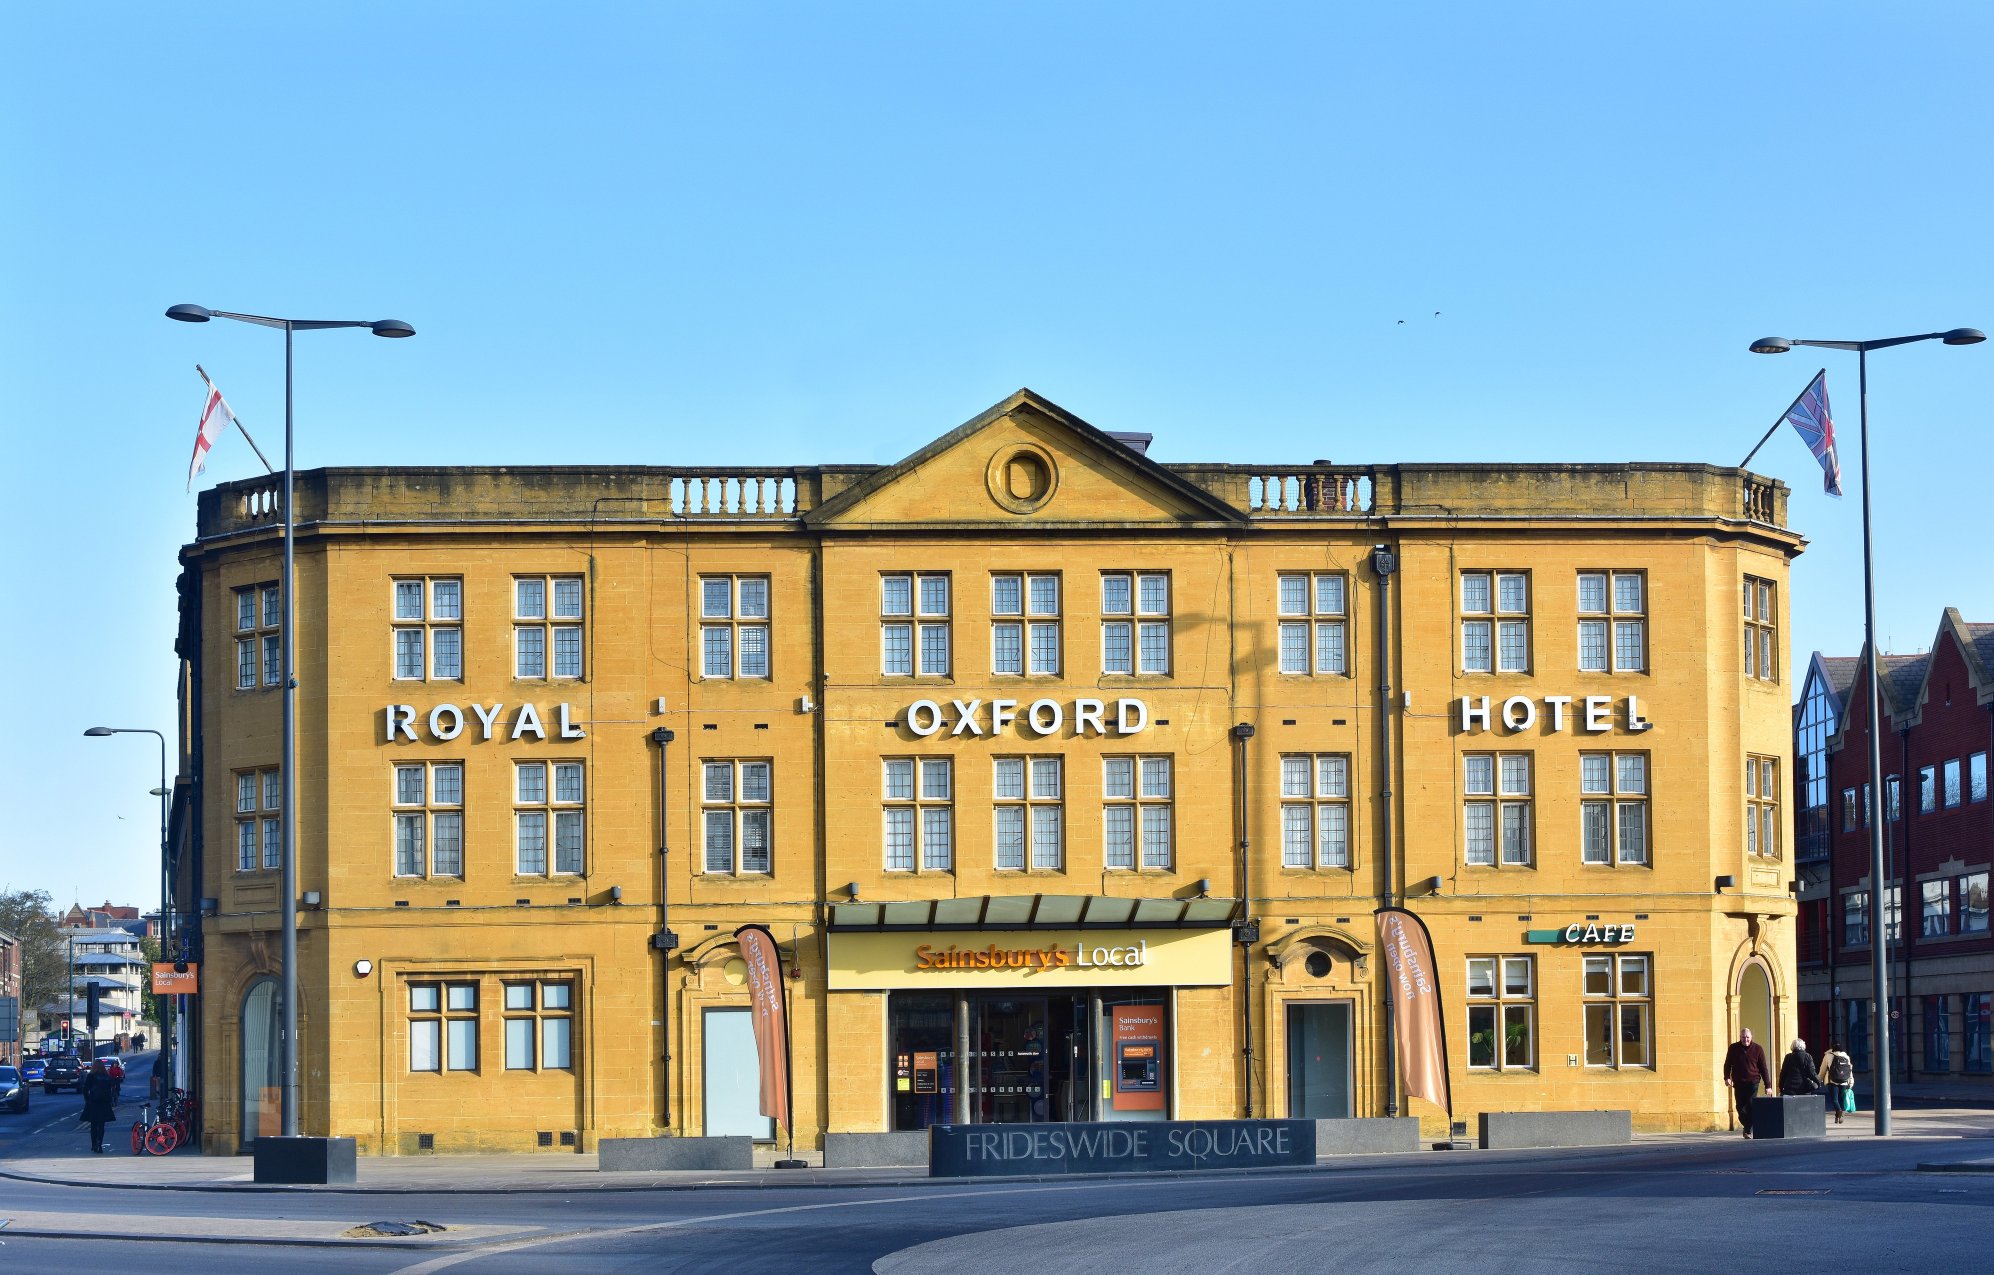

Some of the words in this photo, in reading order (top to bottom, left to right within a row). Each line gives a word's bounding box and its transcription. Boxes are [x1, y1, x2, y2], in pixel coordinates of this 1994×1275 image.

[386, 703, 587, 741] ROYAL
[907, 698, 1148, 736] OXFORD
[1462, 695, 1653, 731] HOTEL
[1565, 922, 1635, 943] CAFE
[915, 943, 1070, 974] Sainsbury's
[1077, 939, 1148, 967] Local
[155, 971, 194, 979] Sainsbury's
[1119, 1017, 1158, 1025] Sainsbury's
[1568, 1055, 1577, 1066] H
[966, 1129, 1148, 1160] FRIDESWIDE
[1168, 1127, 1290, 1160] SQUARE
